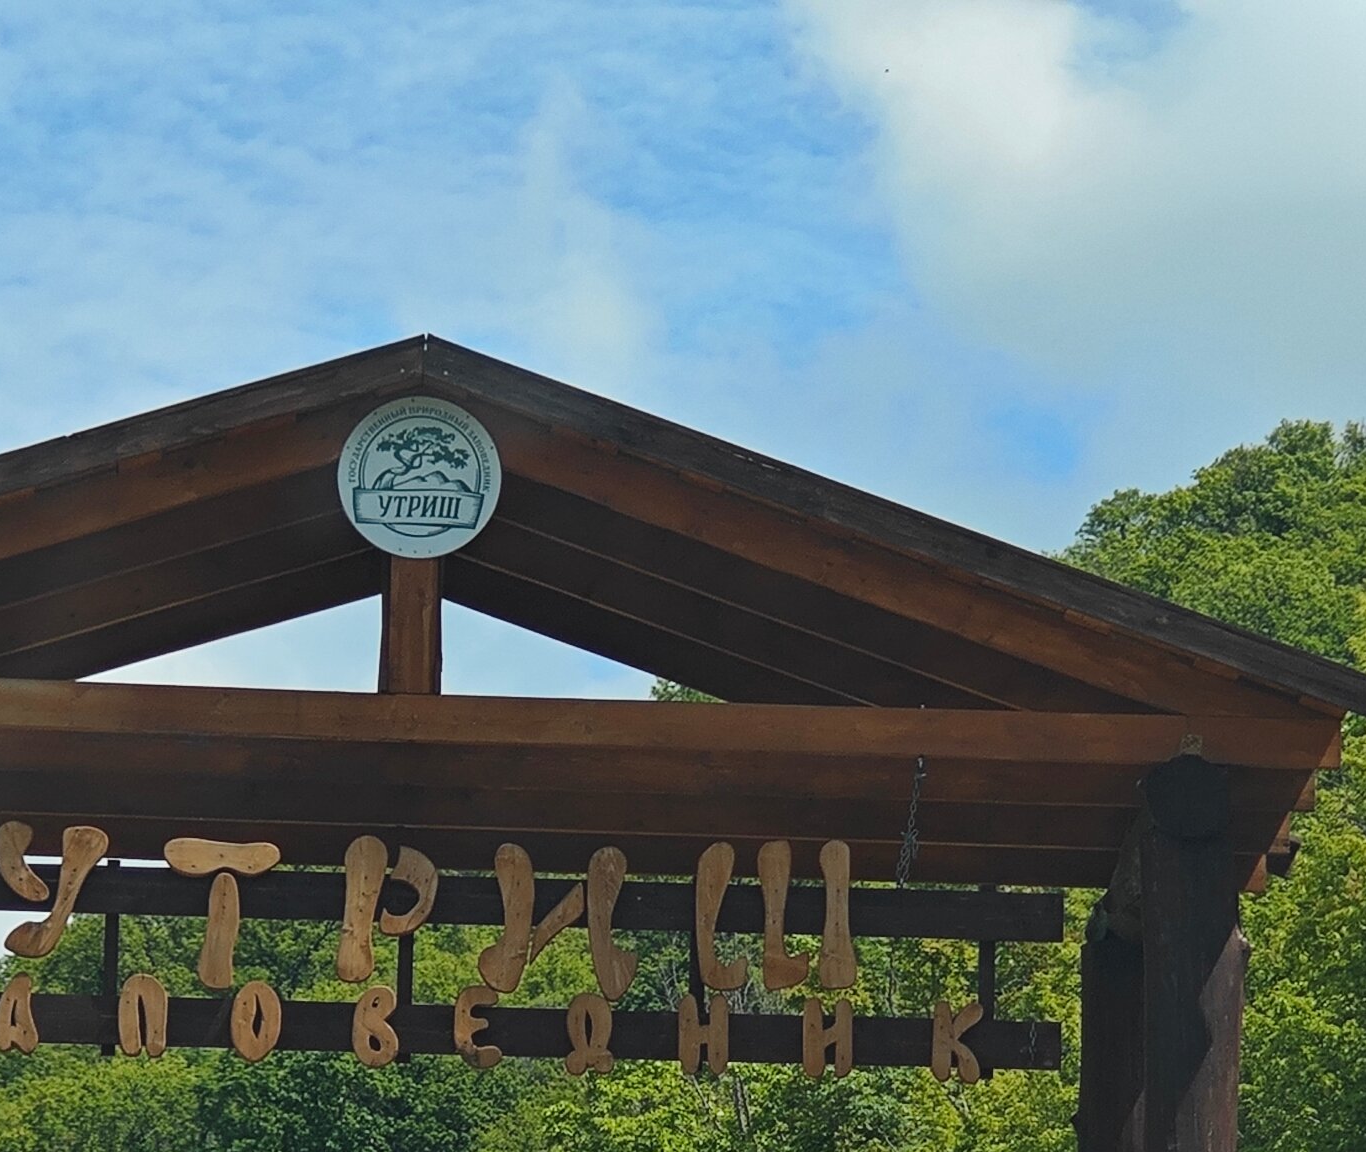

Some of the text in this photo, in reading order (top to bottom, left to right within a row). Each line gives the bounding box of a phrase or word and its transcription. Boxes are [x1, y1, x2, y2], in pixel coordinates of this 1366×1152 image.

[348, 407, 407, 483] ГОСУДАРСТВЕННЫЙ
[407, 405, 470, 436] ПРИРОДНЫЙ
[378, 494, 462, 520] УТРИШ
